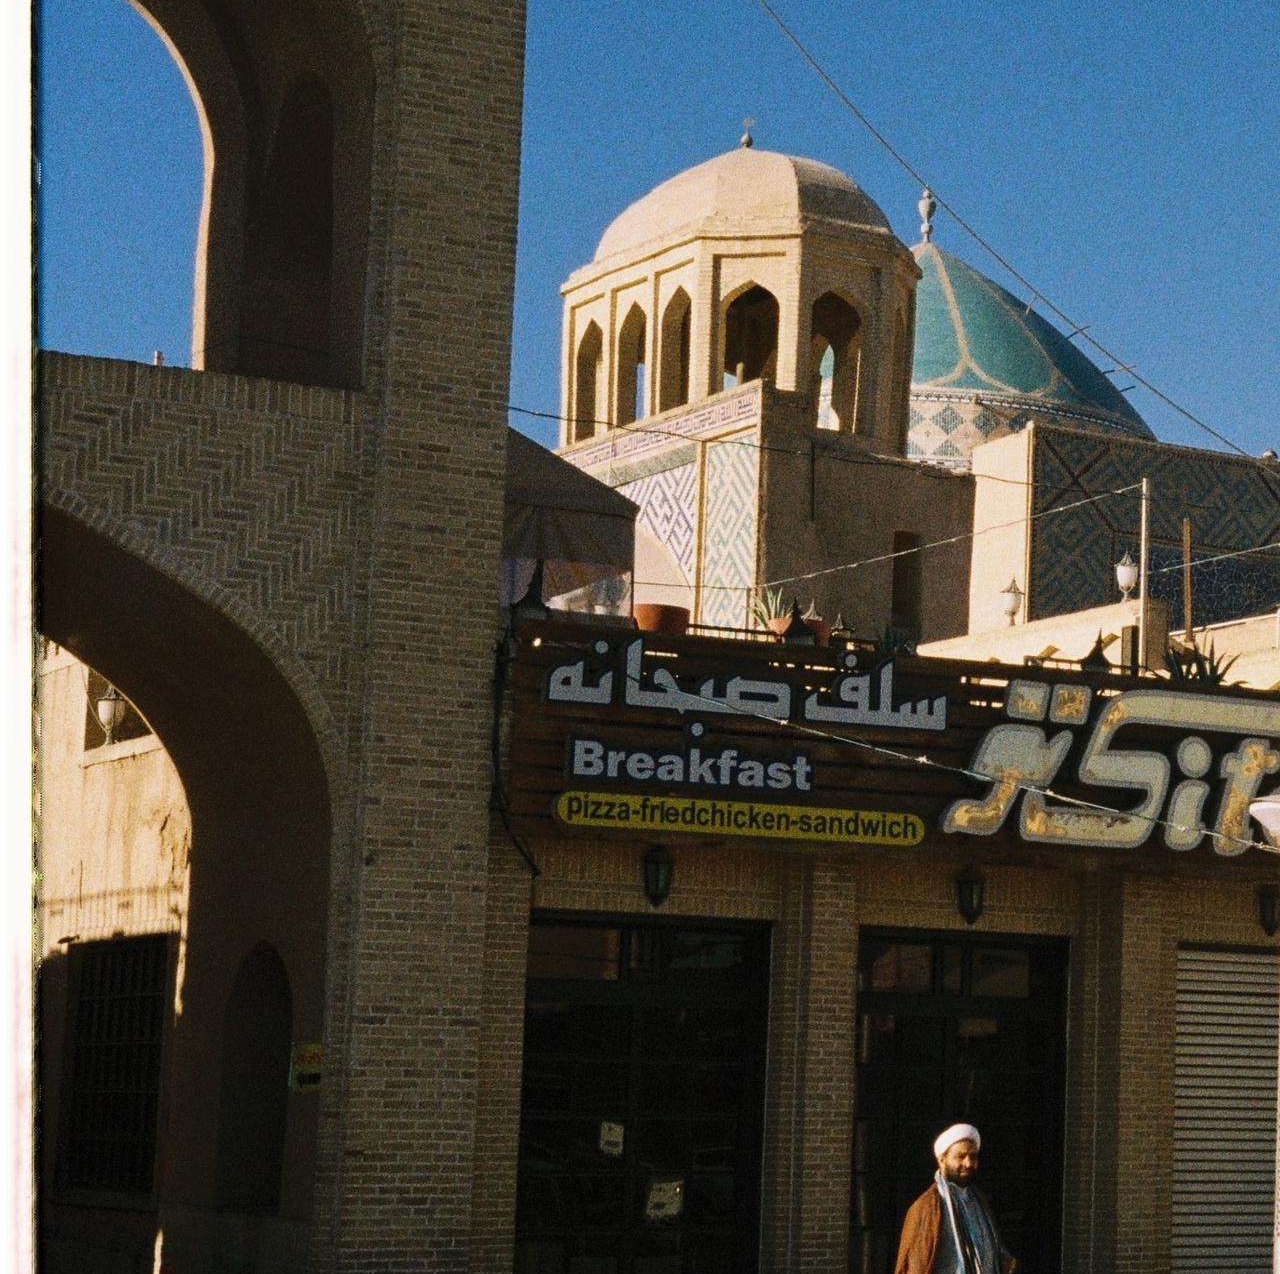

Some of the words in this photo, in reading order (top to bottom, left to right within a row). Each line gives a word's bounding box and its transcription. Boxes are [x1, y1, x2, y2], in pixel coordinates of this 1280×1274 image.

[548, 638, 791, 737] صبحانه
[804, 653, 947, 731] سلف
[573, 739, 811, 791] Breakfast
